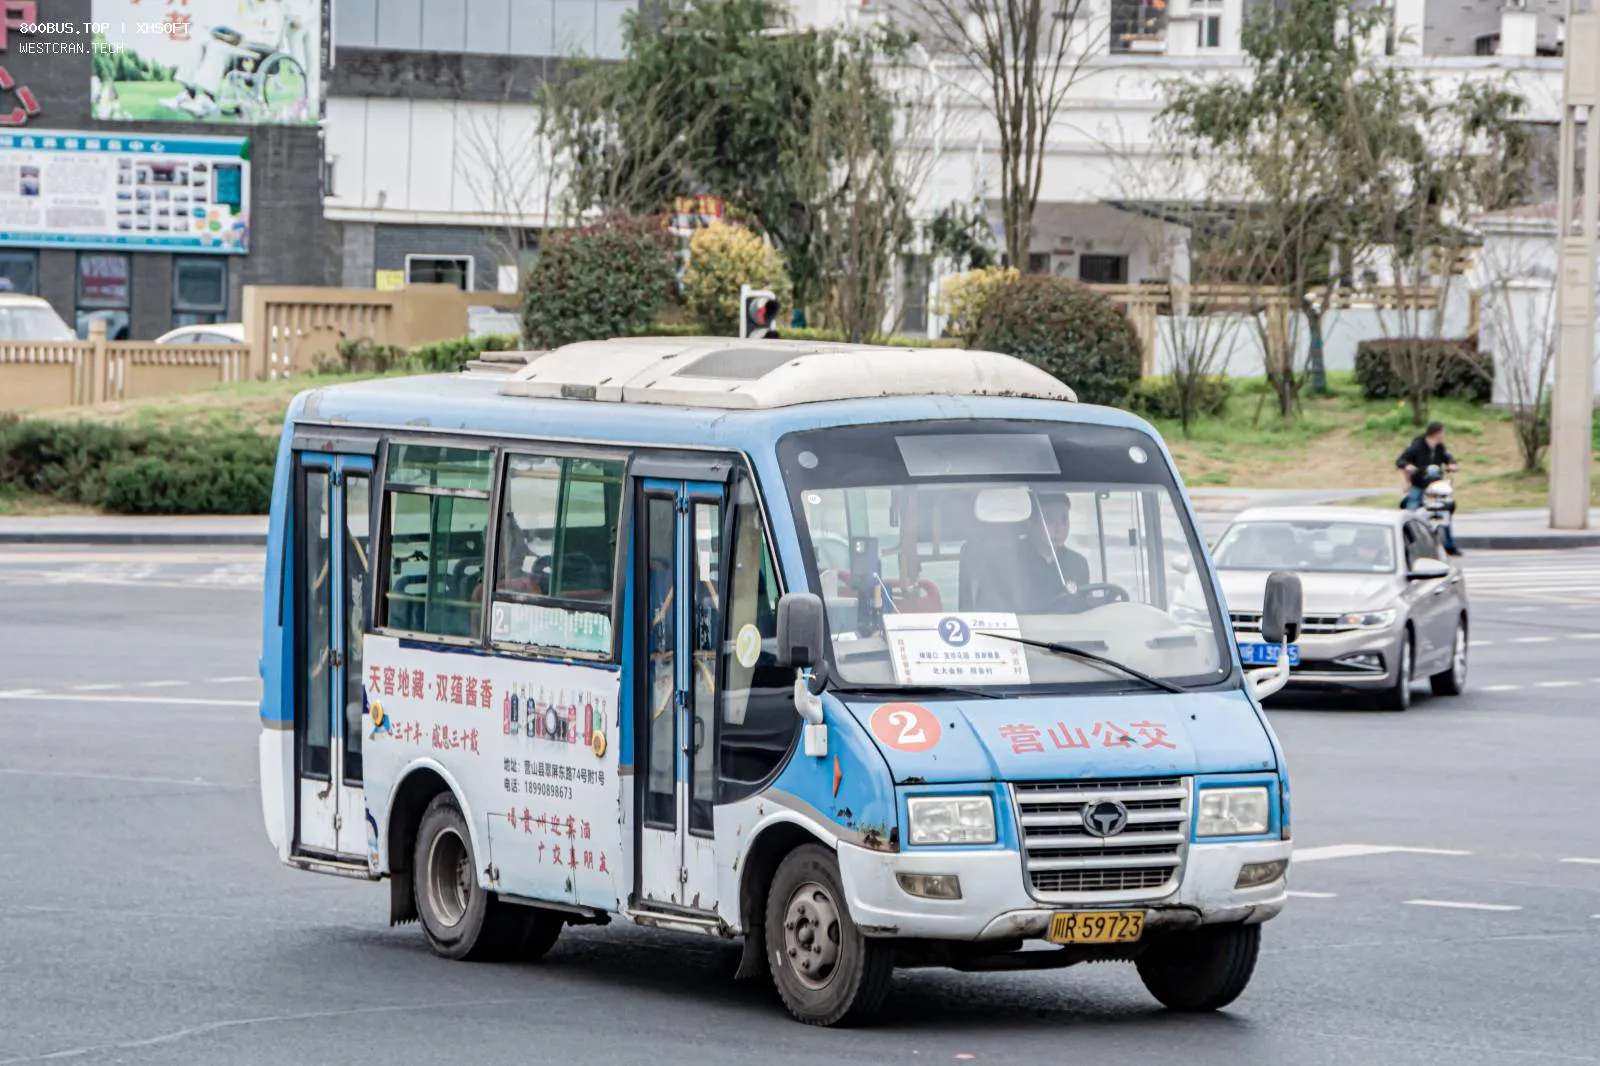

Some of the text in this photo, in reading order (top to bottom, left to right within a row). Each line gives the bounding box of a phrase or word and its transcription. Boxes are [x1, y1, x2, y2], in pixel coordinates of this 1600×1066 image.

[944, 620, 965, 642] 2
[742, 632, 758, 666] 2
[888, 710, 928, 745] 2
[998, 720, 1178, 754] 营山公交
